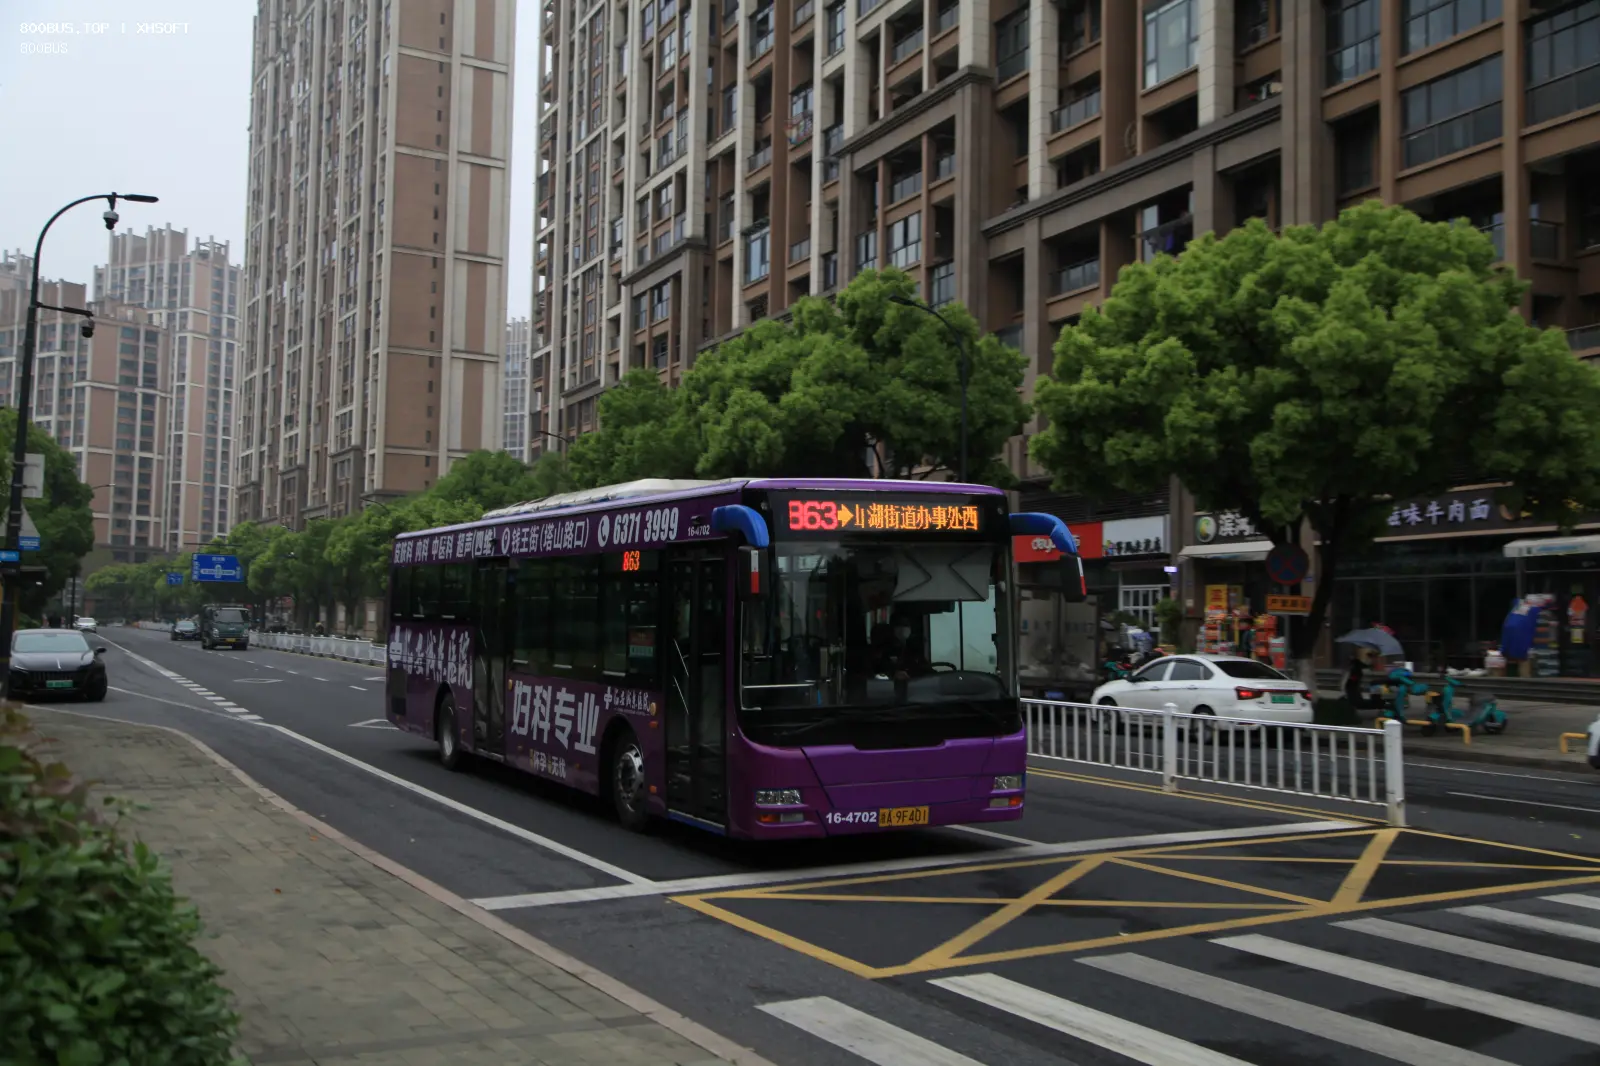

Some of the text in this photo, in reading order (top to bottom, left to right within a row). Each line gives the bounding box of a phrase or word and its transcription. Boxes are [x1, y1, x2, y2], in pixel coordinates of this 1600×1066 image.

[431, 534, 454, 561] 中医科
[613, 512, 642, 545] 6371
[643, 507, 680, 543] 3999
[622, 551, 641, 572] 863
[511, 680, 600, 755] 妇科专业
[825, 811, 877, 825] 16-4702
